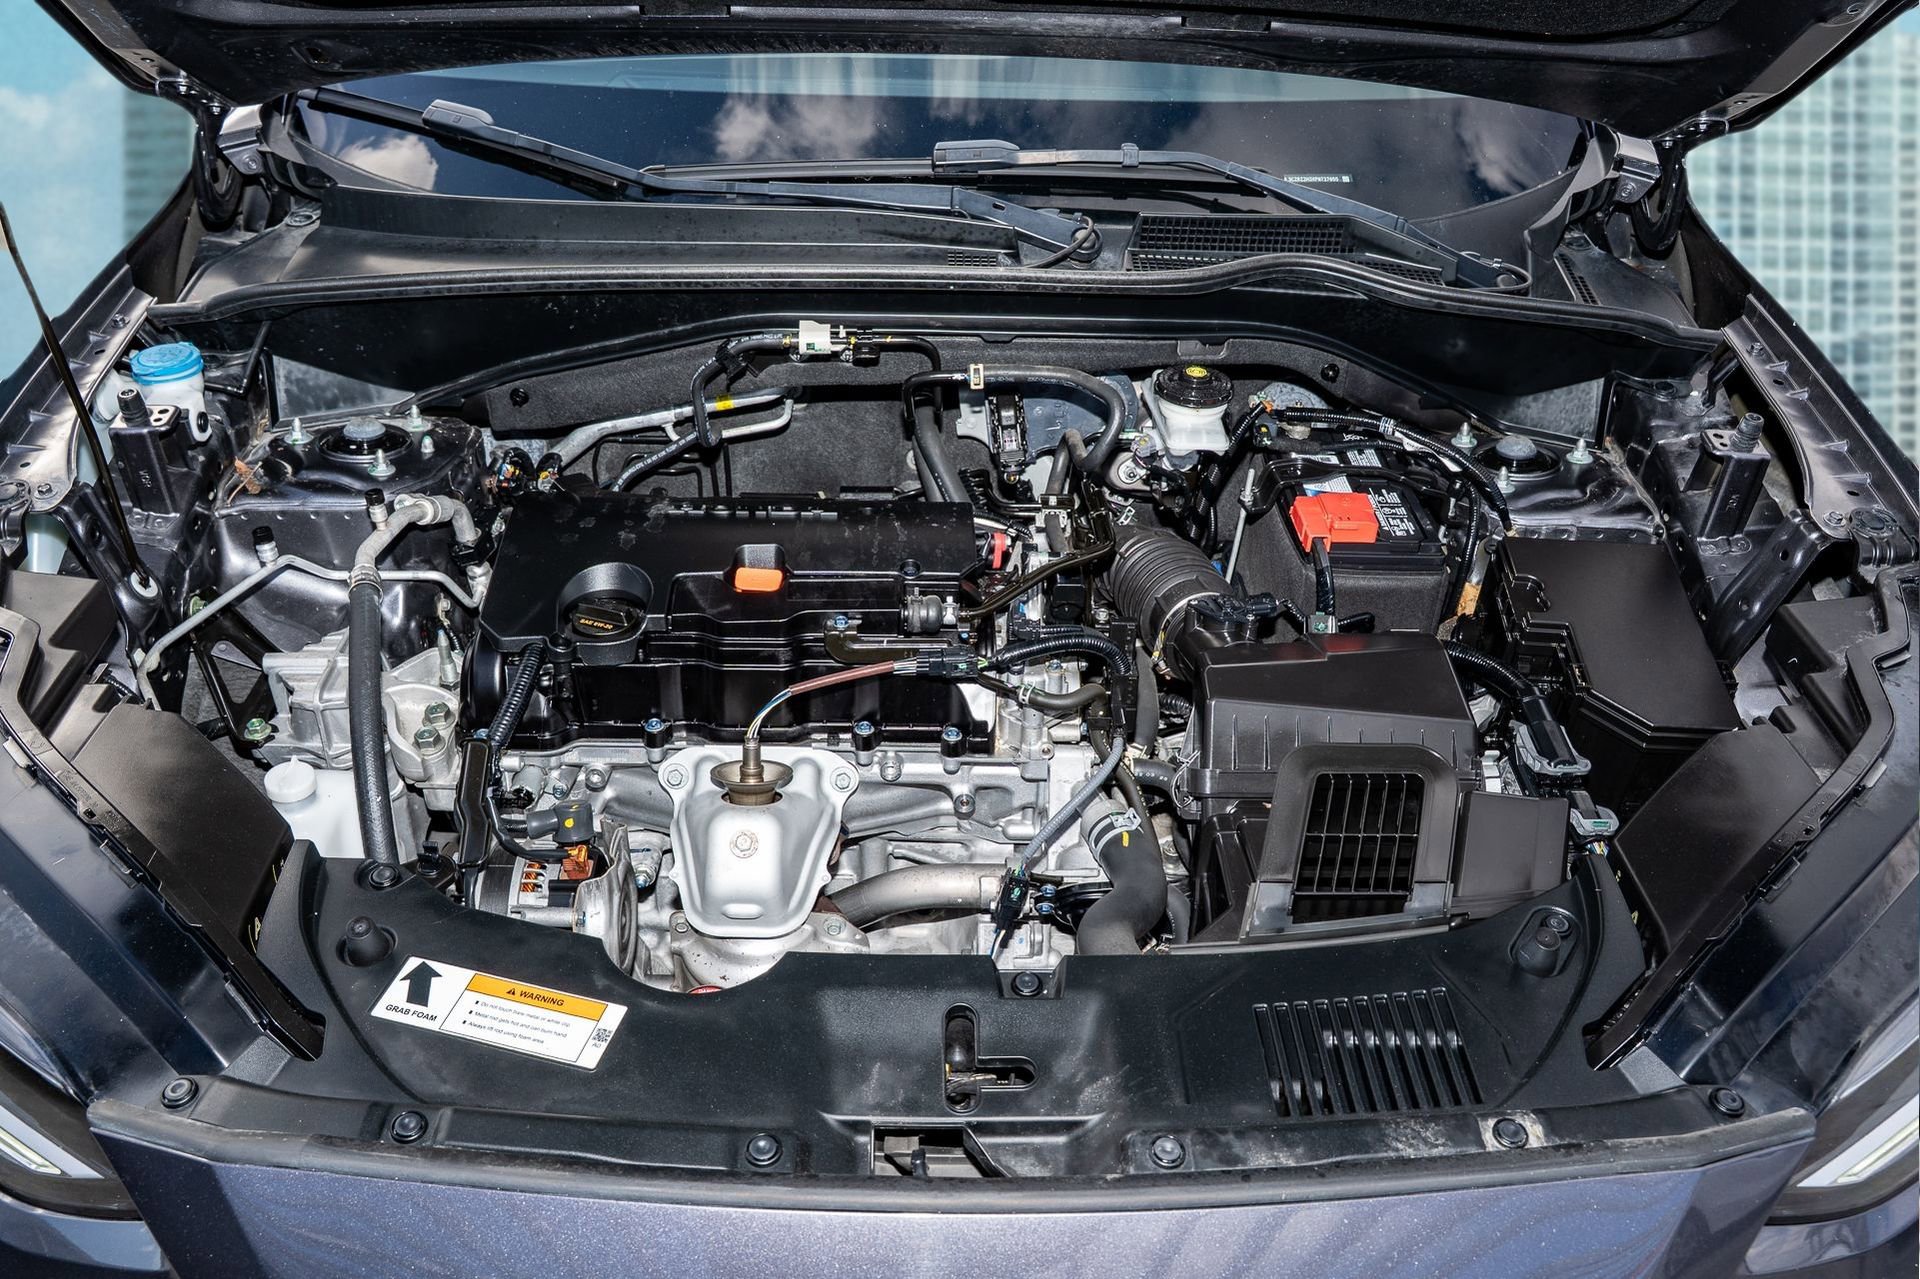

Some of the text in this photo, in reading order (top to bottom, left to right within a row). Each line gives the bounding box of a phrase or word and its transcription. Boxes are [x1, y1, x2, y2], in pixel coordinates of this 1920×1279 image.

[520, 990, 564, 1006] WARNING
[386, 1004, 437, 1021] GRAB FOAM
[468, 1021, 486, 1029] Always
